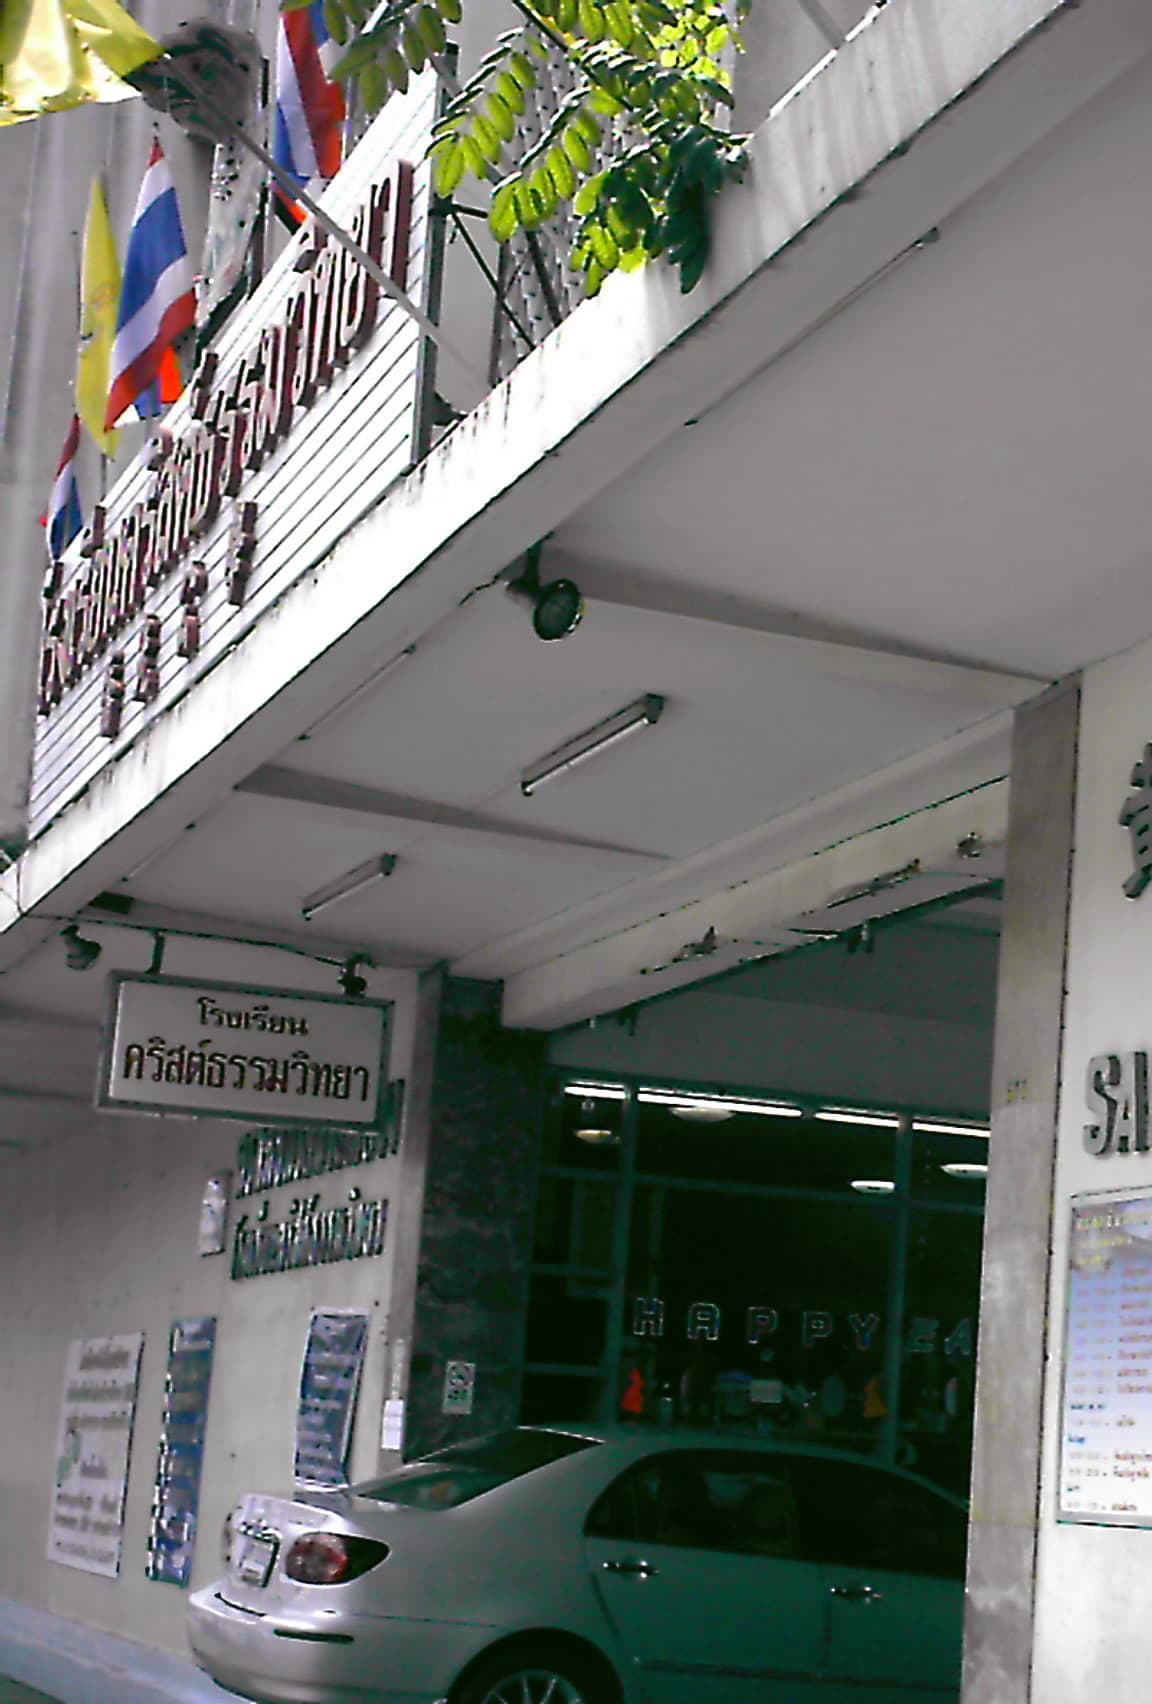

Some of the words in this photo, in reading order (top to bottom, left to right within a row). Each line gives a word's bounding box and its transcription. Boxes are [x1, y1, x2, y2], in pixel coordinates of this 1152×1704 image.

[196, 996, 309, 1036] โรงเรียน
[632, 1296, 881, 1350] HAPPY
